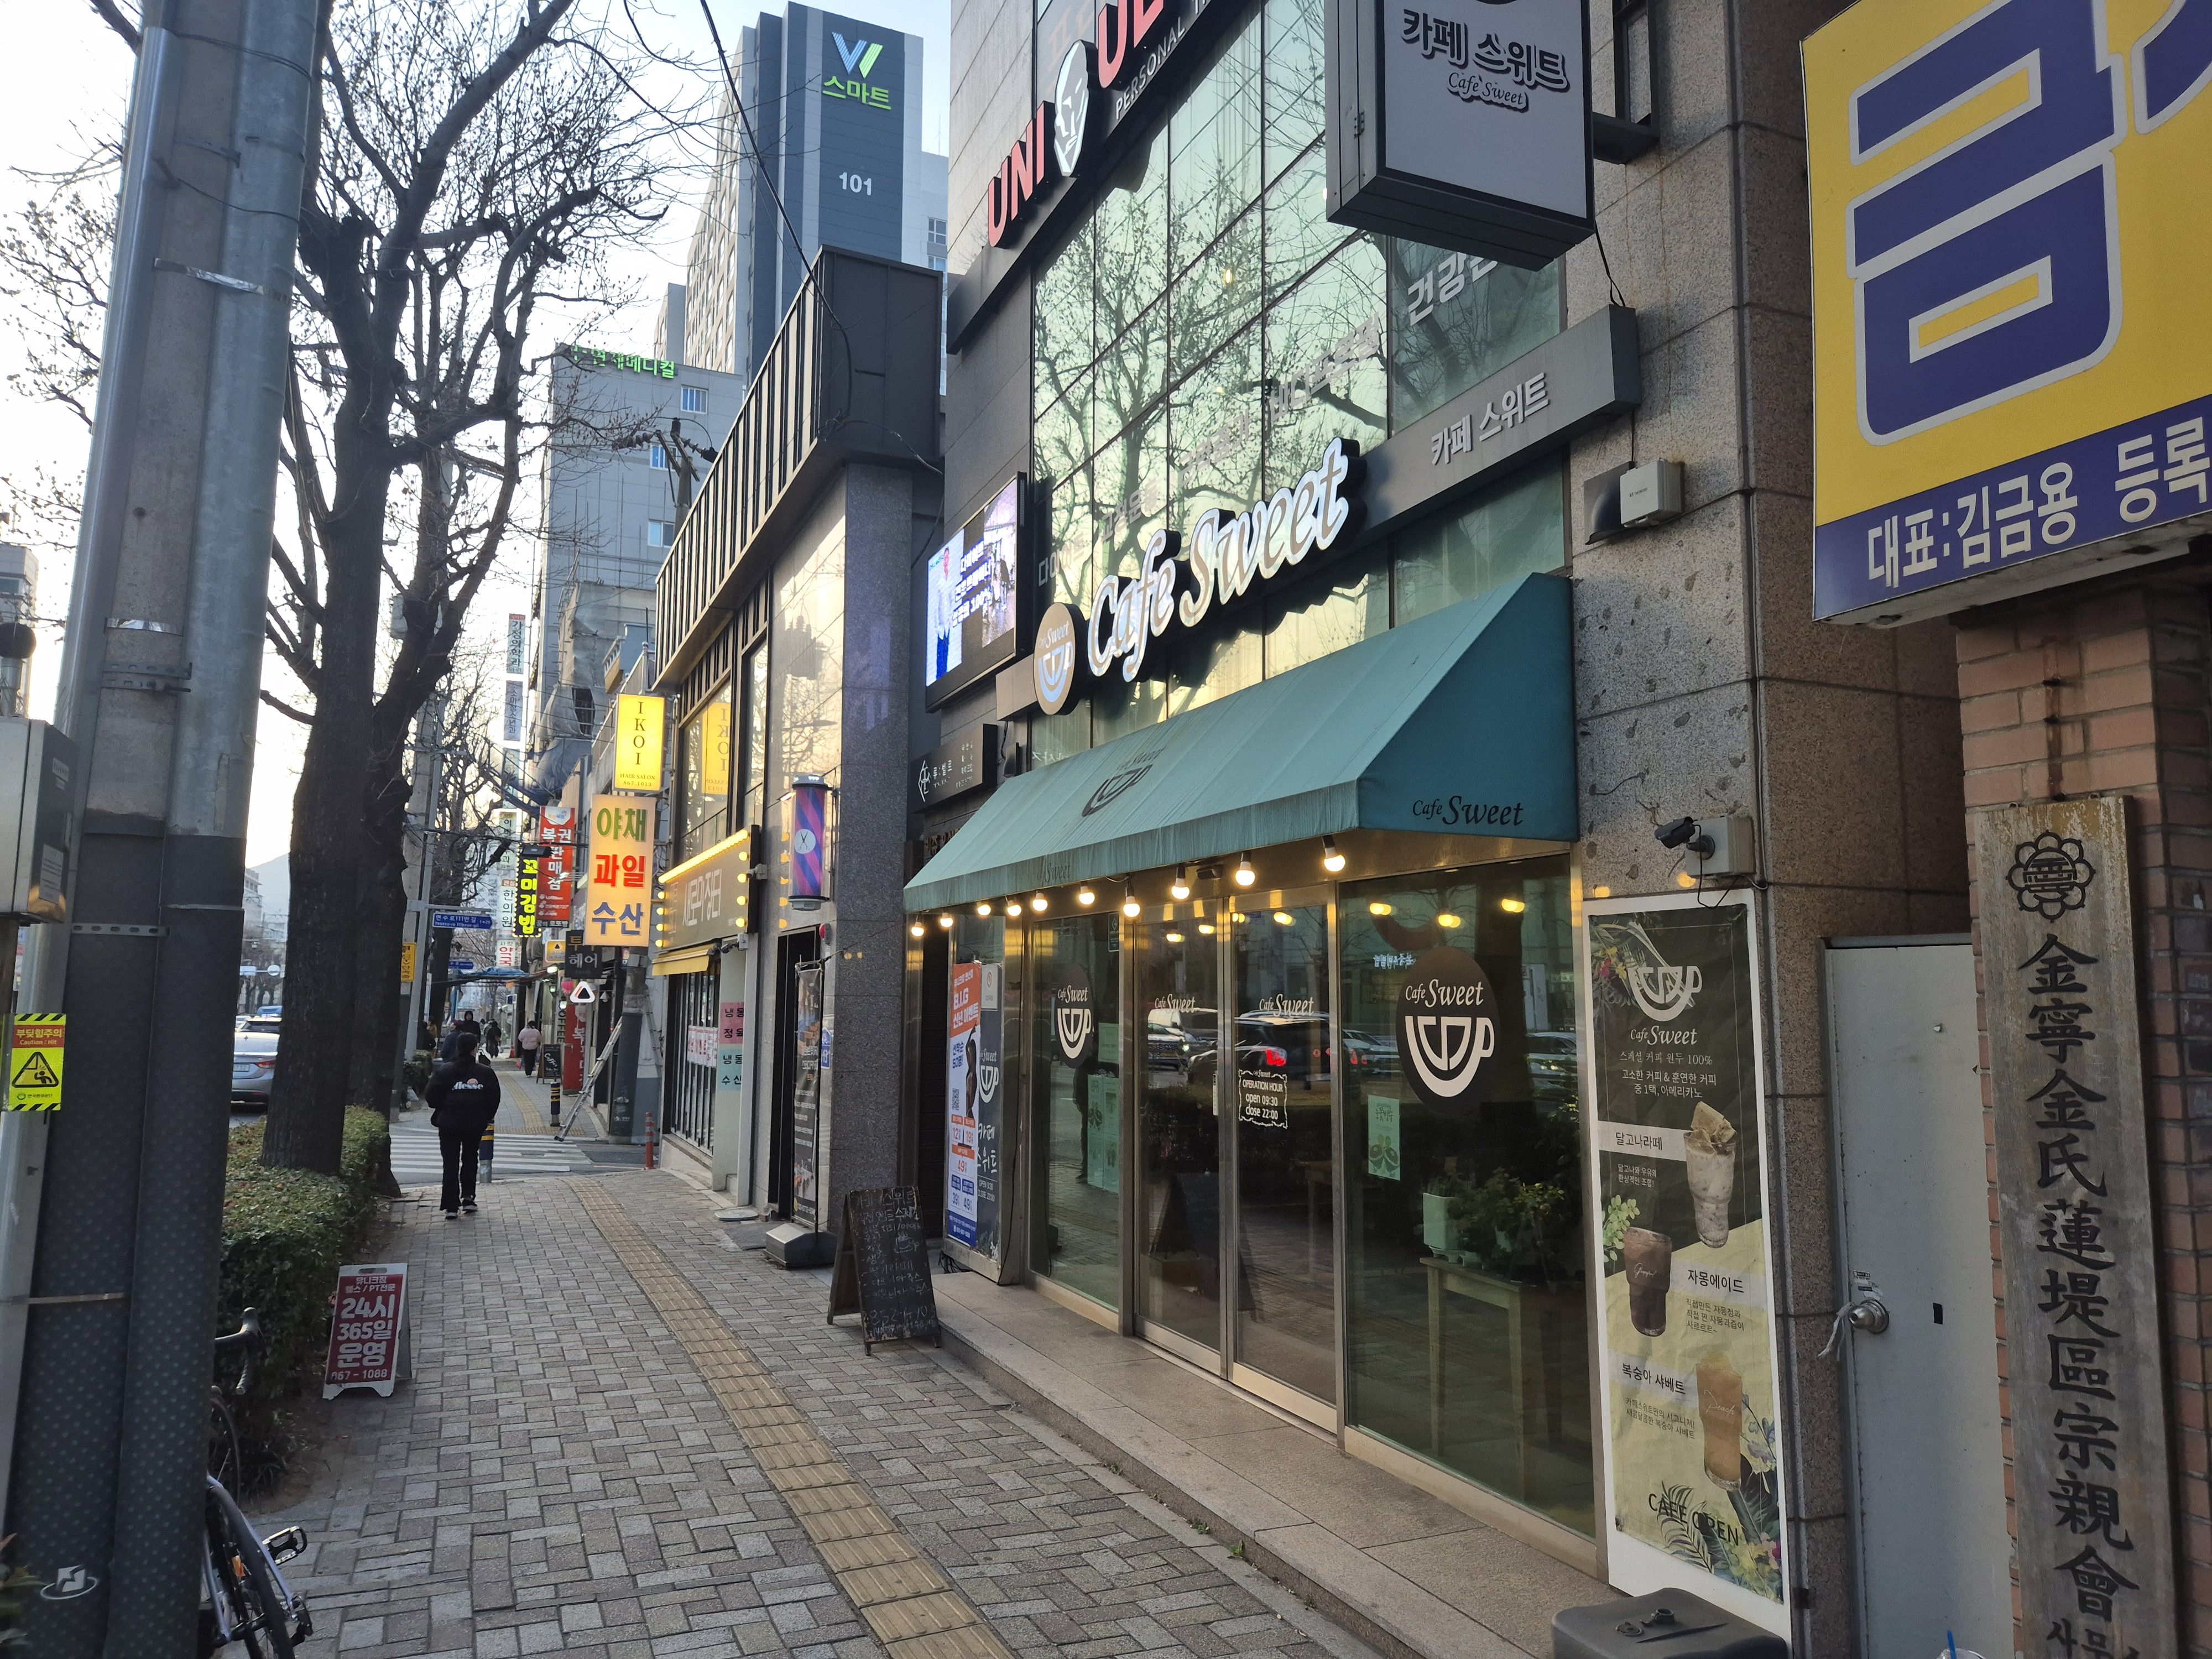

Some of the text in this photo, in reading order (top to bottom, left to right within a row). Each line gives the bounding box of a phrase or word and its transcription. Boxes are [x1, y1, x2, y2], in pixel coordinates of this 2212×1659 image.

[1402, 8, 1566, 86] 카페 스위트
[1115, 17, 1186, 121] PERSONAL
[822, 75, 892, 110] 스마트
[1482, 82, 1524, 106] Sweet
[838, 171, 873, 196] 101
[1431, 372, 1550, 465] 카페 스위트
[2115, 416, 2212, 524] 등록
[1087, 437, 1349, 682] Cafe Sweet
[1046, 620, 1070, 649] Sweet
[633, 701, 646, 765] IKOI
[1412, 795, 1524, 826] Cafe Sweet
[596, 807, 646, 842] 야채
[593, 854, 645, 889] 과일
[502, 890, 514, 927] 한의원
[592, 901, 645, 936] 수산
[568, 953, 598, 968] 헤어
[1065, 984, 1088, 1003] Sweet
[1155, 993, 1196, 1014] Cafe Sweet
[1405, 979, 1484, 1006] Cafe Sweet
[1259, 993, 1314, 1017] Cafe Sweet
[1630, 1025, 1698, 1046] Cafe Sweet
[723, 1054, 743, 1065] 냉동
[1619, 1051, 1713, 1066] 스페셜 커피 원두 100%
[1258, 1069, 1271, 1078] Sweet
[1621, 1069, 1717, 1086] 고소한 커피 & 훈연한 커피
[1242, 1079, 1284, 1093] OPERATION HOUR
[1634, 1083, 1642, 1094] 중
[1660, 1084, 1703, 1098] 아메리카노
[1245, 1093, 1279, 1107] open 09:30
[1245, 1103, 1279, 1120] close 22:00
[1616, 1131, 1663, 1151] 달고나라떼
[1618, 1164, 1640, 1176] 달고나와
[1687, 1269, 1745, 1294] 자몽에이드
[340, 1293, 395, 1319] 24시
[337, 1319, 393, 1341] 365일
[337, 1340, 387, 1368] 운영
[362, 1369, 388, 1379] 1088
[1621, 1362, 1687, 1395] 복숭아 샤베트
[1675, 1425, 1696, 1440] 샤베트
